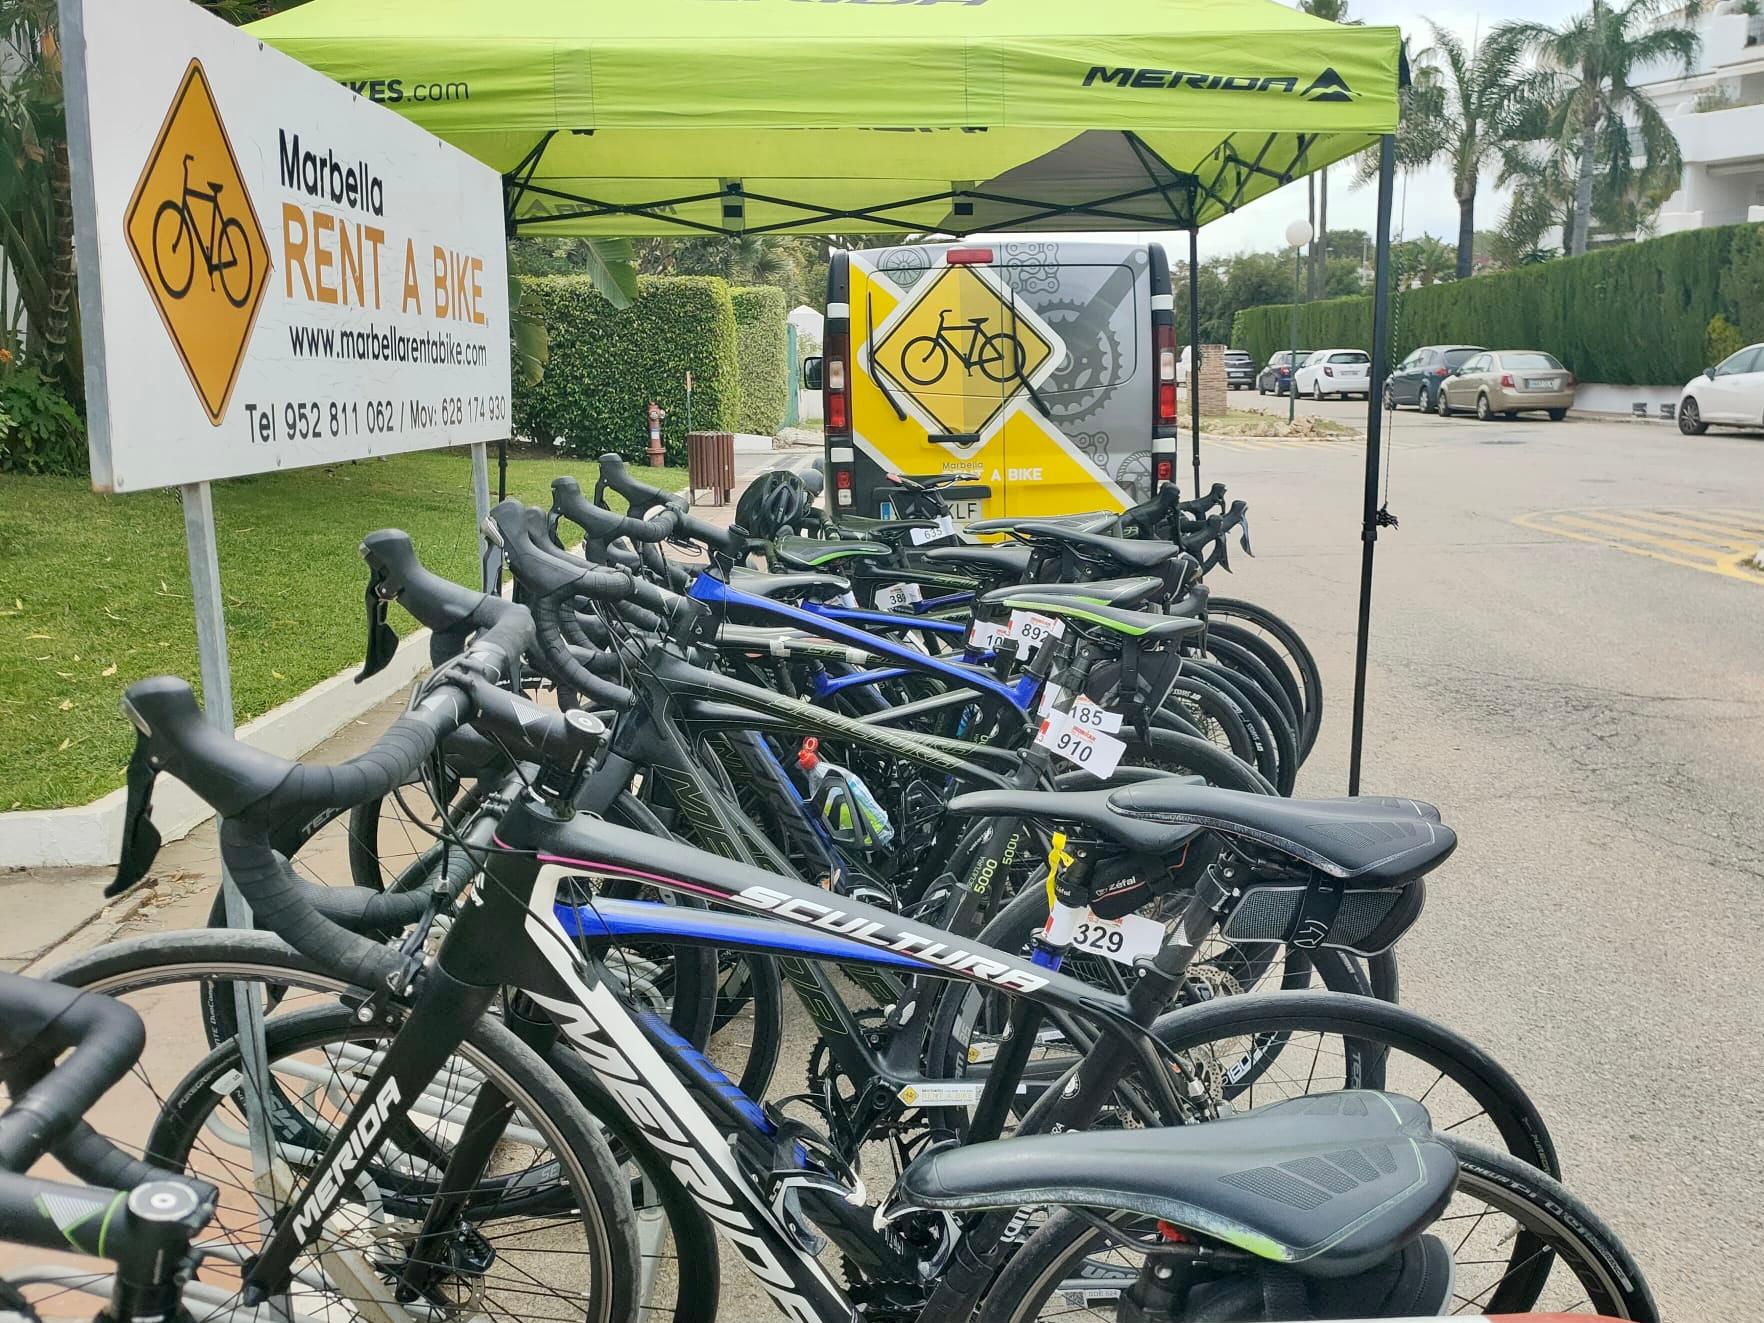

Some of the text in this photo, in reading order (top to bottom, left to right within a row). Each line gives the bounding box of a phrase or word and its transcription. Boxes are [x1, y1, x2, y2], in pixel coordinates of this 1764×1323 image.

[1082, 66, 1298, 92] MERIDA
[279, 128, 384, 217] Marbella
[282, 202, 486, 325] RENT A BIKE
[289, 323, 488, 366] www.marbellarentabike.com
[245, 403, 276, 443] Tel
[284, 401, 322, 440] 952
[329, 400, 359, 437] 811
[366, 400, 394, 433] 062
[410, 399, 437, 429] Mov:
[441, 397, 463, 426] 628
[468, 396, 485, 422] 174
[488, 395, 506, 421] 930
[942, 461, 984, 470] Marbella
[991, 470, 1002, 481] A
[1008, 468, 1043, 481] BIKE
[924, 528, 943, 540] 635
[1071, 706, 1104, 726] 185
[1057, 734, 1093, 762] 910
[974, 858, 998, 894] 5000
[732, 885, 1050, 992] SCULTURA
[1073, 924, 1124, 953] 329
[292, 1075, 401, 1245] MERIDA
